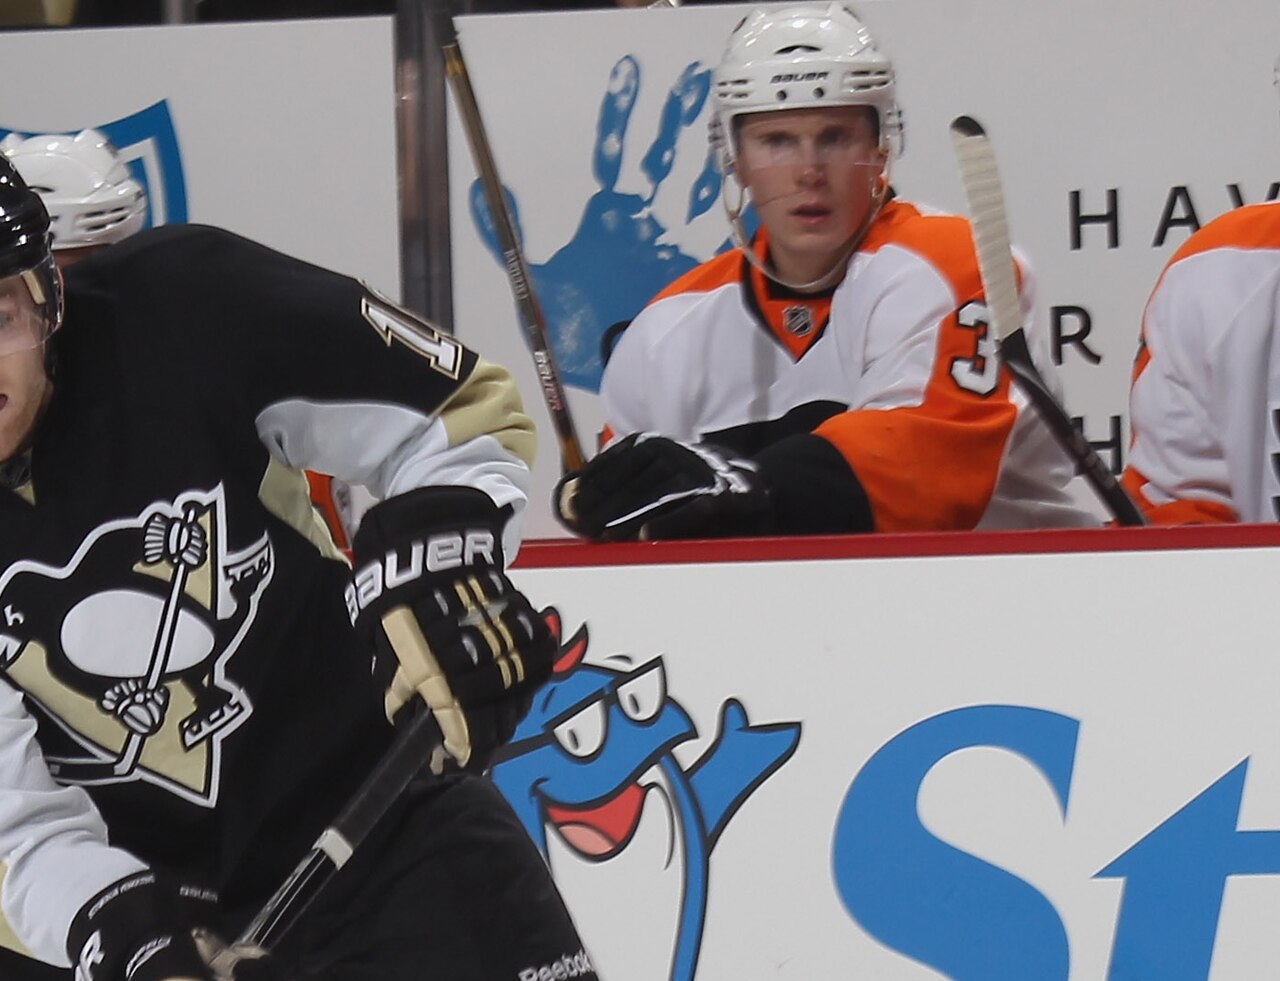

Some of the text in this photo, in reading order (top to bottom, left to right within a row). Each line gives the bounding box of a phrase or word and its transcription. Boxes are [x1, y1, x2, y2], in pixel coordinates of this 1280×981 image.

[770, 70, 830, 84] BAUER
[1069, 182, 1280, 250] HA
[949, 300, 1001, 397] 3
